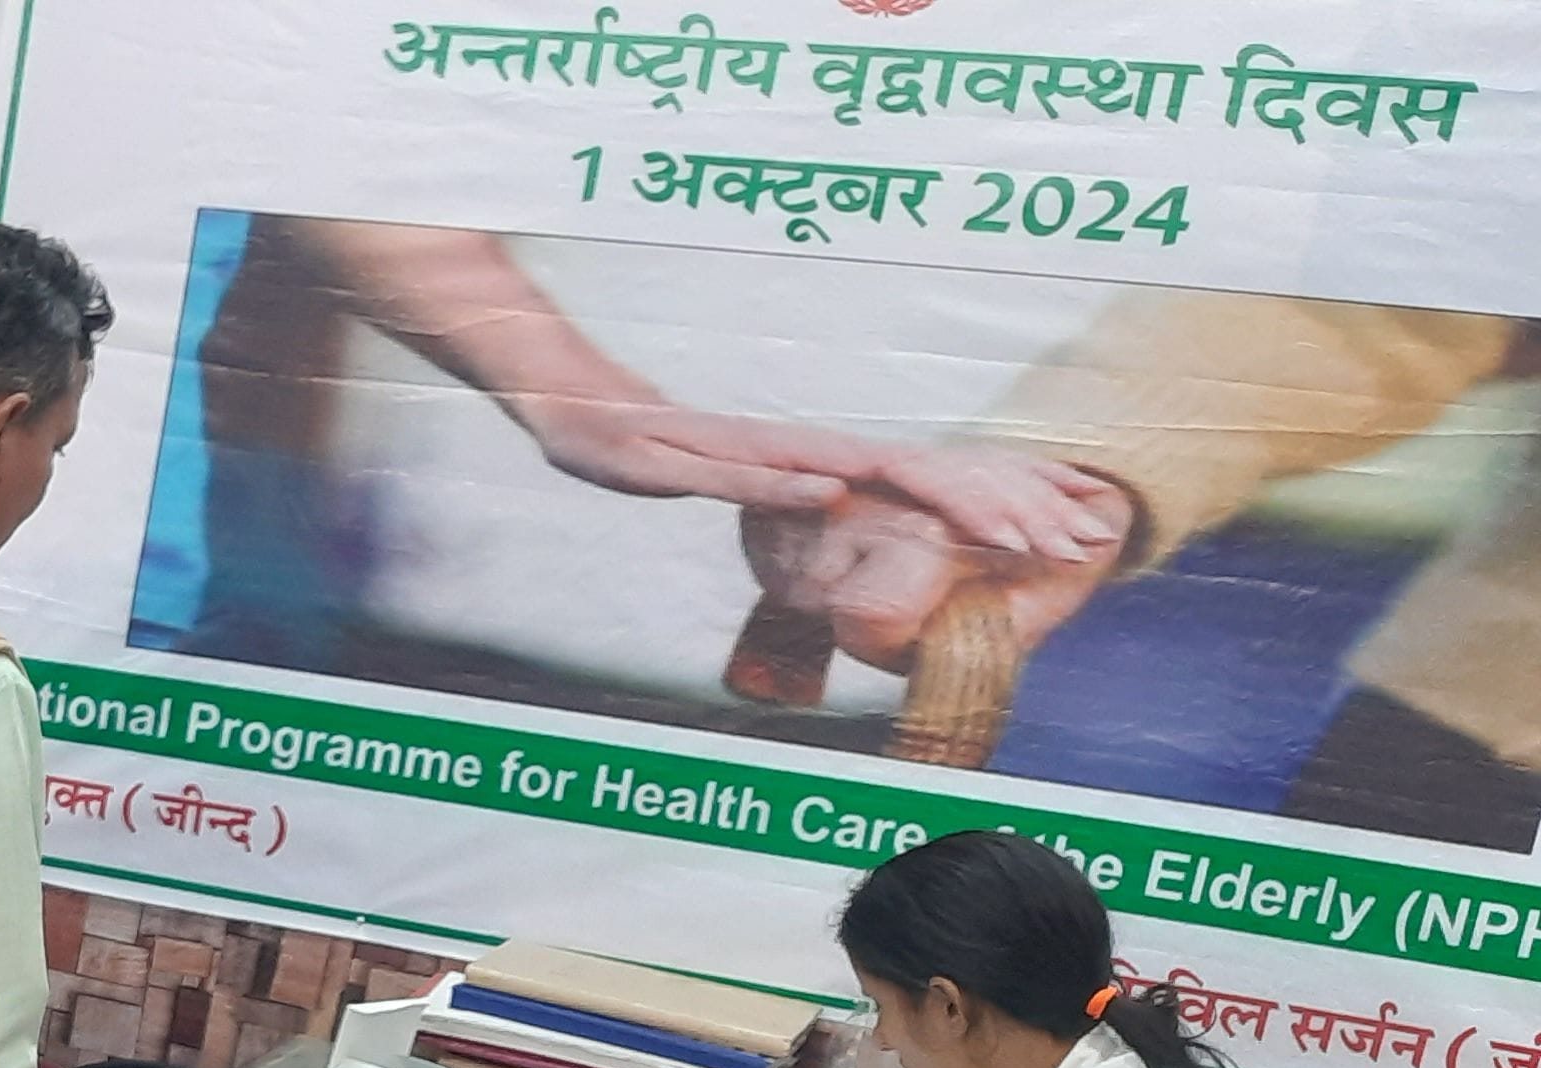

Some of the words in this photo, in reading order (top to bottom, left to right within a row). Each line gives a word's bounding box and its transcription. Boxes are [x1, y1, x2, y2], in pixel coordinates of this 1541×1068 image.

[1223, 43, 1479, 146] दिवस
[571, 145, 604, 201] 1
[631, 150, 943, 244] अक्टूबर
[962, 171, 1191, 245] 2024
[185, 701, 483, 788] Programme
[500, 750, 577, 802] for
[592, 764, 771, 835] Health
[791, 796, 928, 855] Care
[1033, 833, 1124, 890] he
[1143, 848, 1376, 942] Elderly
